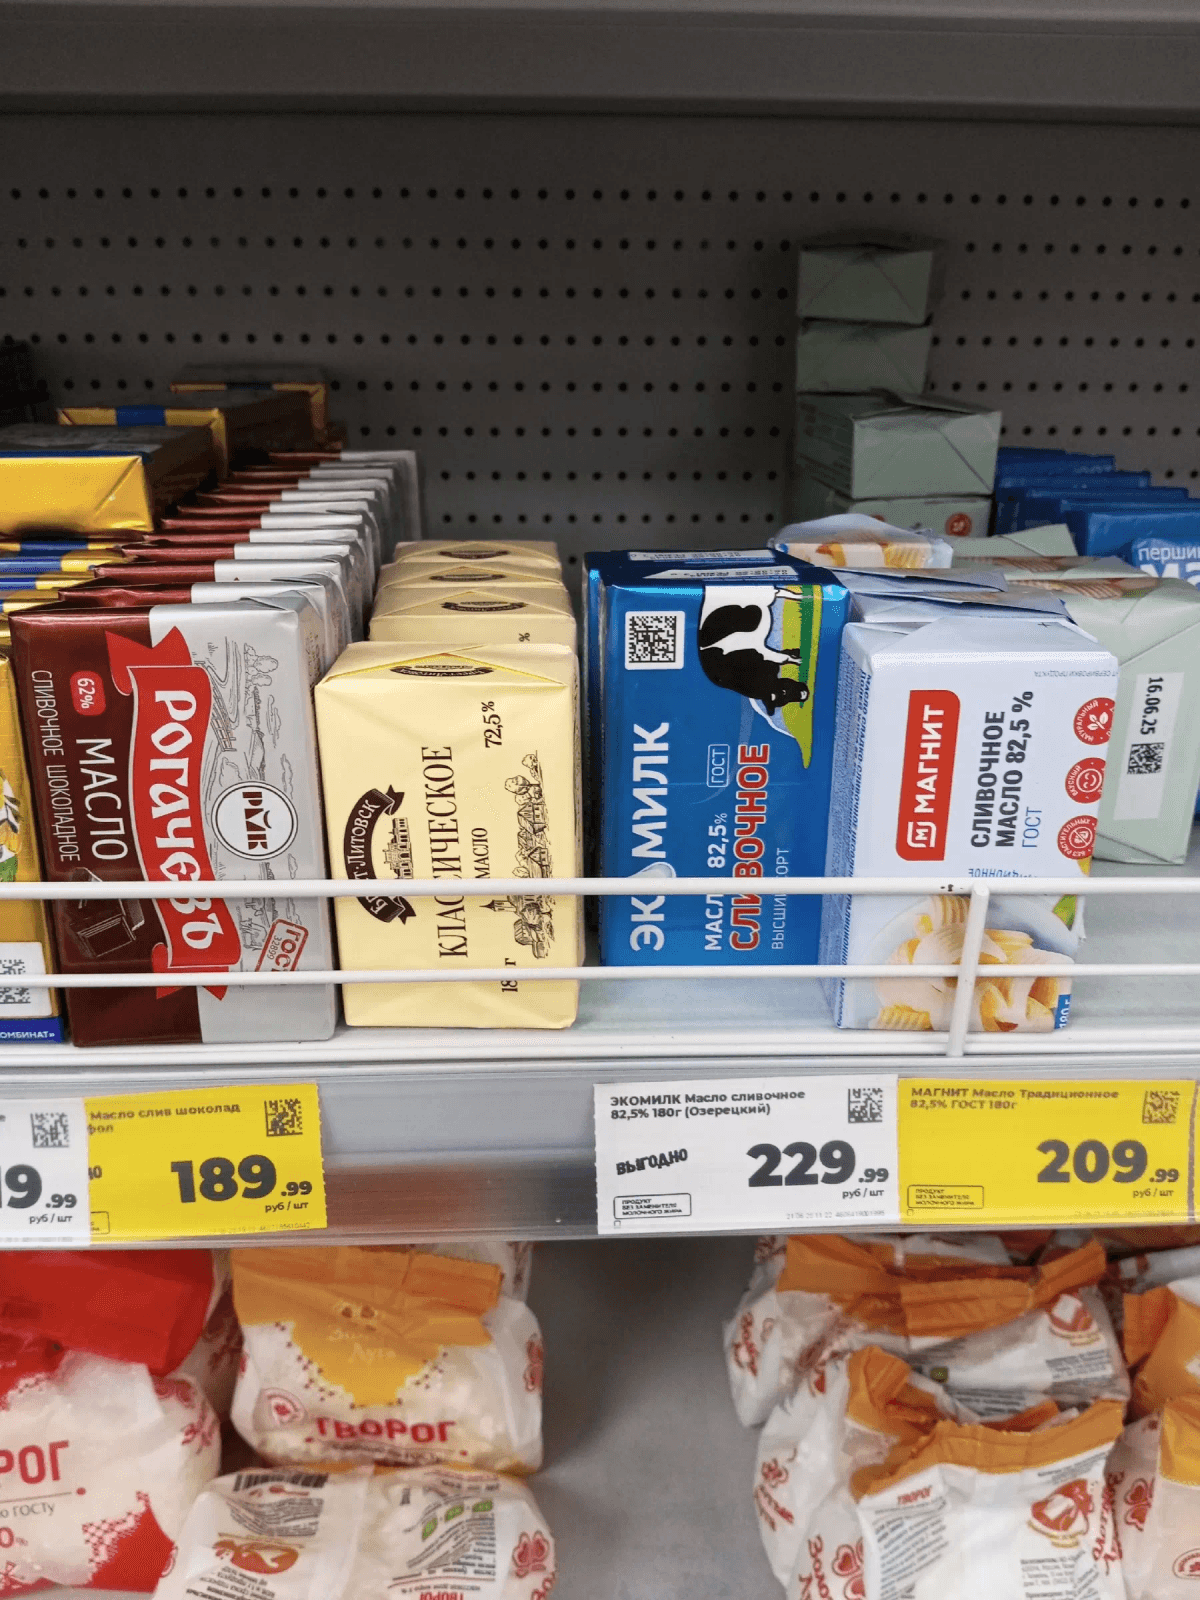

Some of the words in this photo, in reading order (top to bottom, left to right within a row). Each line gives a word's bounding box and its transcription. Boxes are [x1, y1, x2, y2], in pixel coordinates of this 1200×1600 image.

[31, 670, 64, 756] СЛИВОЧНОЕ
[78, 677, 95, 709] 62%
[1140, 677, 1164, 736] 16.06.25
[481, 701, 503, 748] 72,5%
[1008, 720, 1031, 765] 82,5
[711, 748, 727, 785] ГОСТ
[918, 705, 945, 815] МАГНИТ
[971, 711, 1006, 848] СЛИВОЧНОЕ
[1067, 765, 1083, 796] ВКУСНЫЙ
[46, 764, 81, 862] ШОКОЛАДНОЕ
[76, 738, 128, 861] МАСЛО
[995, 771, 1024, 848] МАСЛО
[707, 813, 728, 869] 82,5%
[729, 744, 770, 951] СЛИВОЧНОЕ
[1022, 807, 1043, 848] ГОСТ
[473, 827, 489, 880] МАСЛО
[775, 847, 790, 880] ОРТ
[704, 893, 724, 951] МАСЛ
[771, 893, 786, 950] ВЫСШИ
[138, 1109, 171, 1119] слив
[176, 1103, 241, 1116] шоколад
[610, 1095, 681, 1107] ЭКОМИЛК
[684, 1093, 728, 1104] Масло
[731, 1090, 806, 1102] сливочное
[611, 1109, 649, 1120] 82,5%
[653, 1107, 681, 1118] 180г
[684, 1104, 771, 1119] (Озерецкий)
[910, 1099, 947, 1109] 82,5%
[951, 1099, 984, 1109] ГОСТ
[988, 1100, 1017, 1109] 180г
[911, 1087, 969, 1098] МАГНИТ
[972, 1089, 1015, 1098] Масло
[1019, 1089, 1119, 1100] Традиционное
[265, 1202, 285, 1213] руб
[294, 1200, 308, 1209] шт
[842, 1189, 861, 1199] руб
[869, 1188, 884, 1197] шт
[1133, 1188, 1151, 1198] руб
[1160, 1188, 1174, 1197] шт
[316, 1417, 457, 1443] ТВОРОГ
